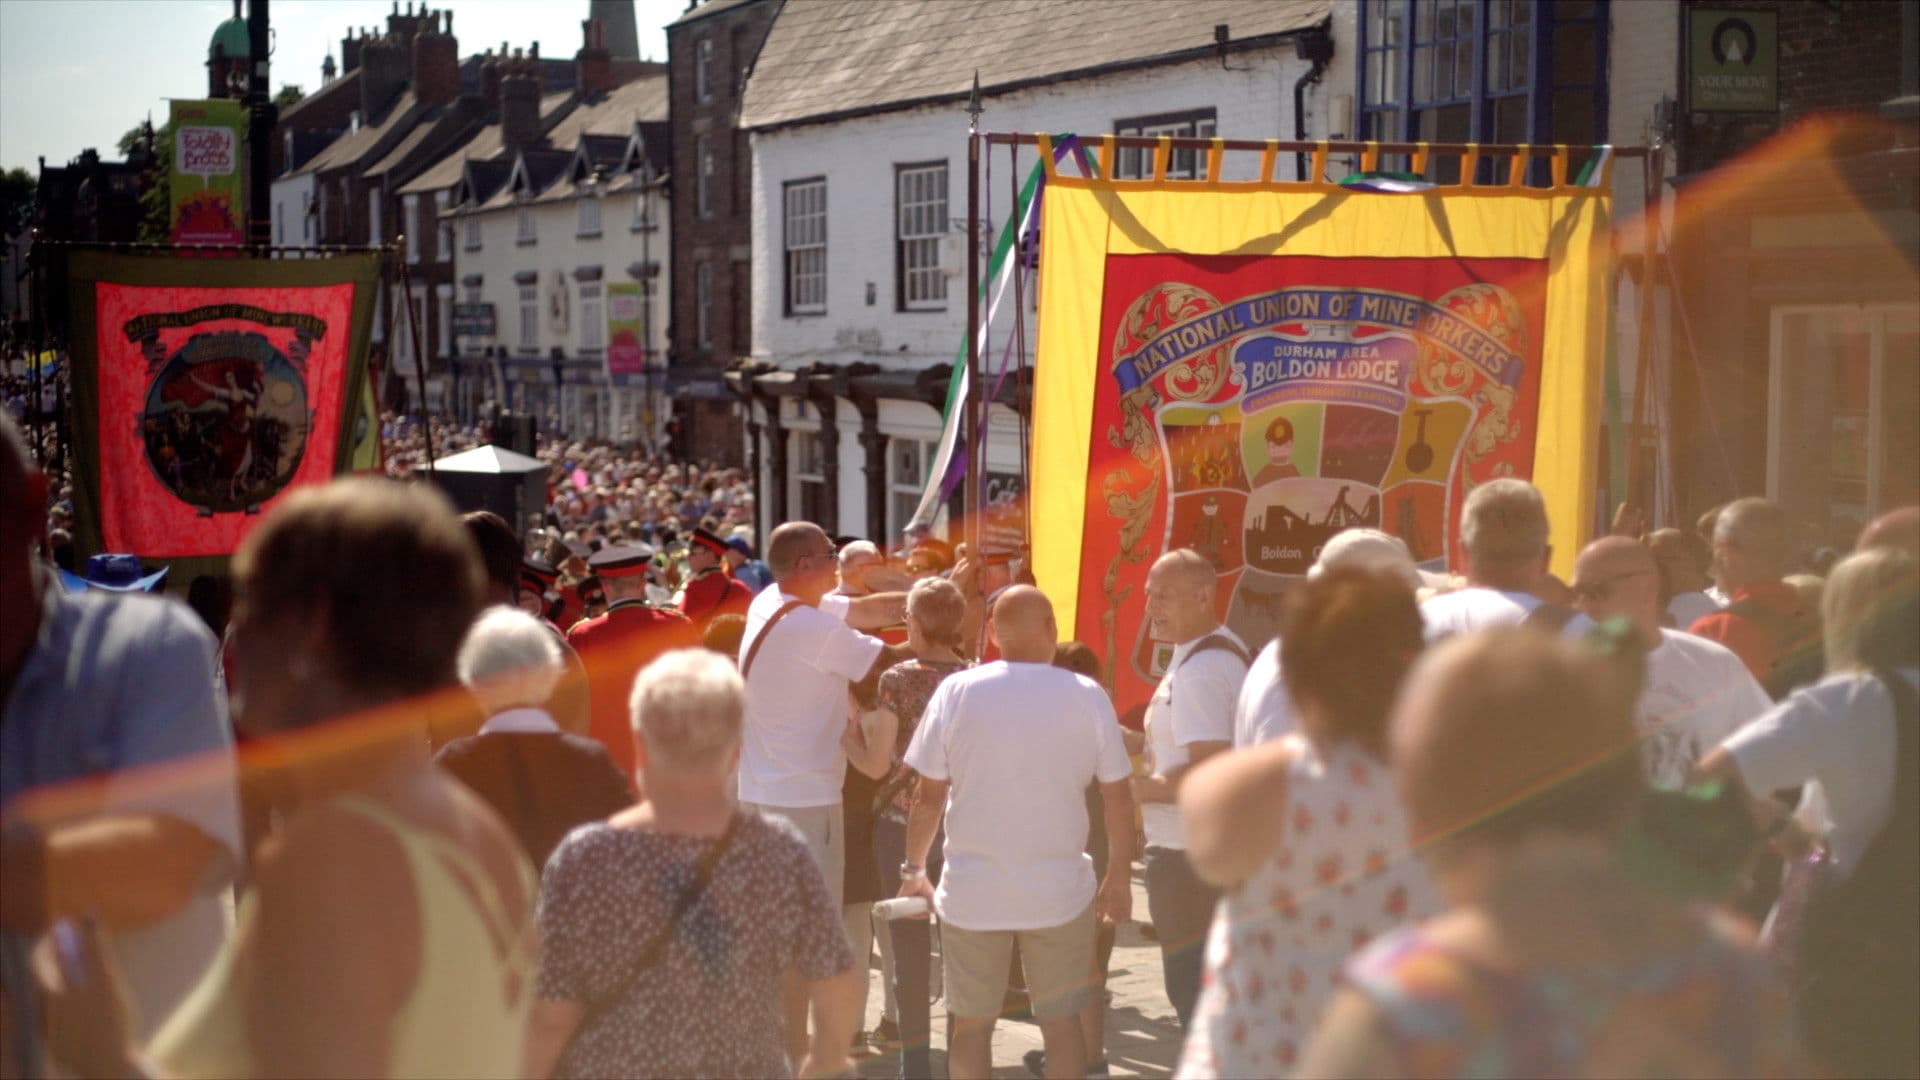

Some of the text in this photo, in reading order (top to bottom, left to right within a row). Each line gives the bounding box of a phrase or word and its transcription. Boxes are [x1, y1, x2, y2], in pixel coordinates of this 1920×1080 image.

[1133, 293, 1508, 379] NATIONAL UNION OF MINEORKERS
[1274, 346, 1379, 359] DURHAM AREA
[1251, 360, 1400, 389] BOLDON LODGE
[1261, 545, 1302, 560] Boldon
